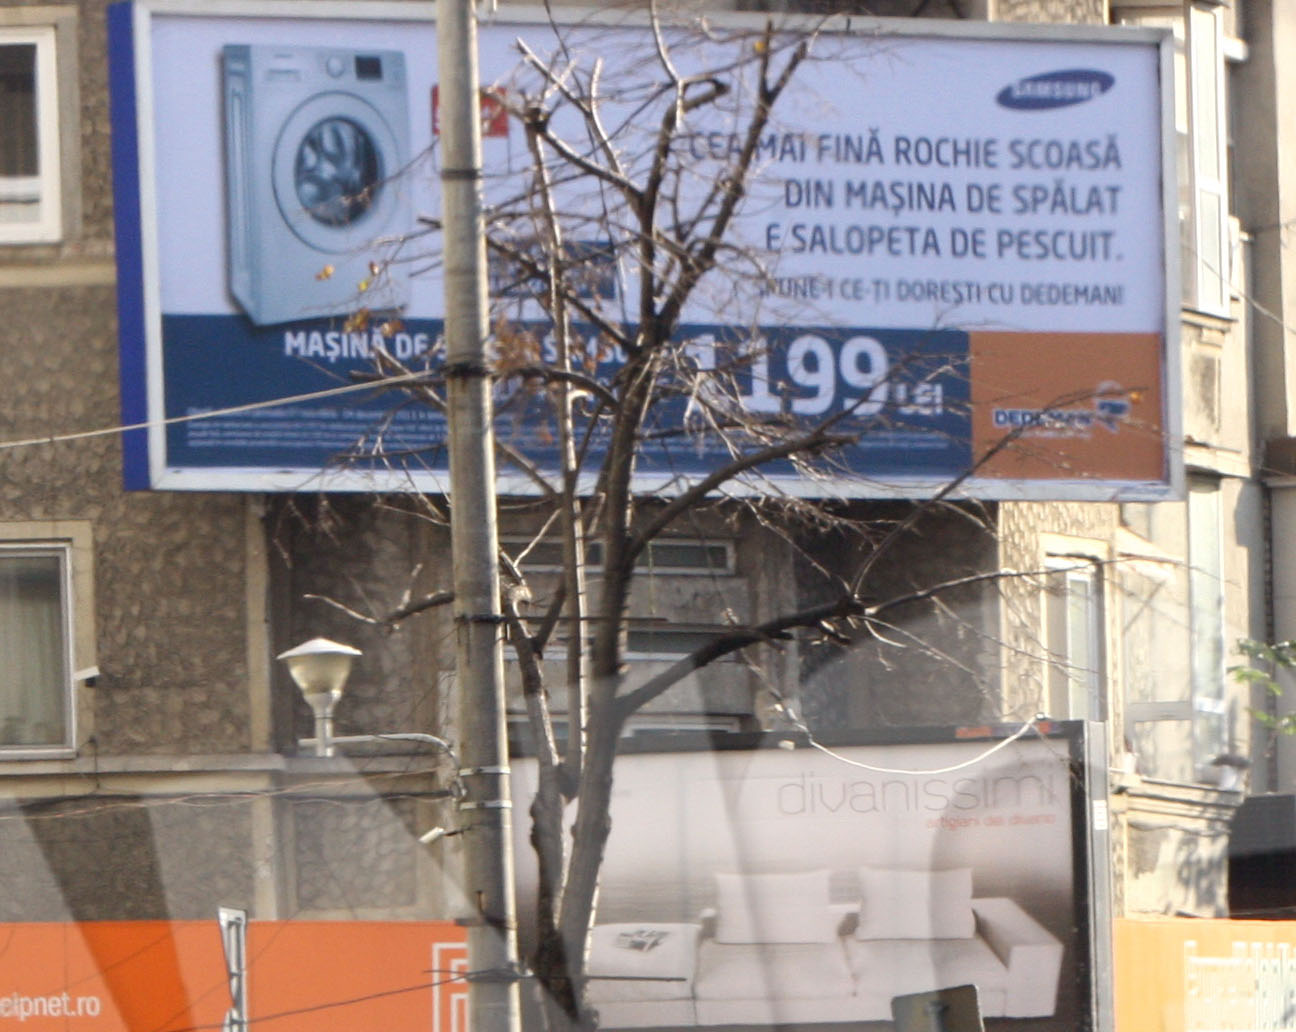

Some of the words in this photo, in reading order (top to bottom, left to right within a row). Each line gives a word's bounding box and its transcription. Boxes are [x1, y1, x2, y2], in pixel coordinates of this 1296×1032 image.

[1010, 80, 1103, 100] SAMSUNG
[753, 133, 806, 162] MAI
[816, 128, 885, 164] FINĂ
[895, 136, 998, 169] ROCHIE
[1009, 133, 1122, 169] SCOASĂ
[785, 179, 833, 208] DIN
[967, 183, 1002, 214] DE
[1013, 180, 1122, 215] SPĂLAT
[765, 223, 781, 251] E
[792, 224, 941, 257] SALOPETA
[951, 228, 986, 258] DE
[997, 230, 1124, 261] PESCUIT.
[987, 283, 1012, 304] CU
[1021, 283, 1124, 306] DEDEMAN!
[777, 769, 1057, 816] divanissimi
